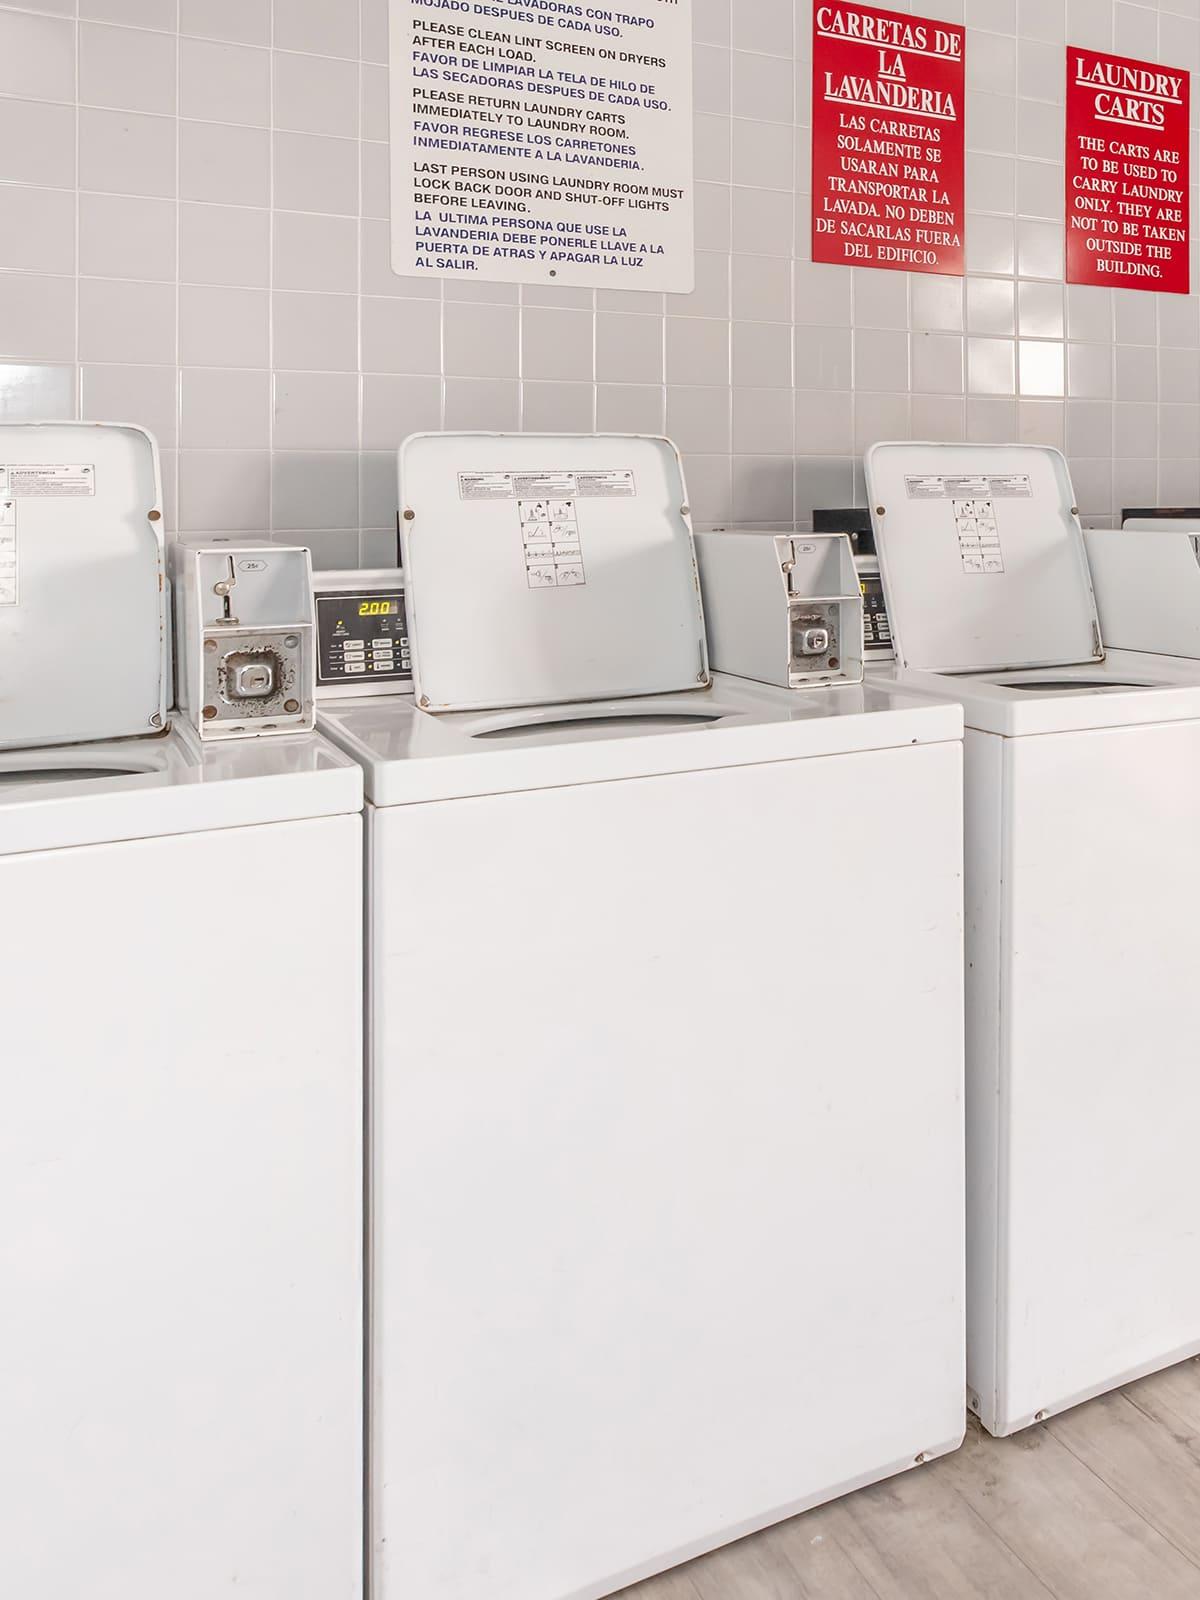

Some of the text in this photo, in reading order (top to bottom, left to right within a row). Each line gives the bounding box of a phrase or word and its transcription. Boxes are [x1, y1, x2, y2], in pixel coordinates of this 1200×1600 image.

[474, 4, 534, 23] DESPUES
[538, 15, 554, 26] DE
[558, 18, 592, 32] CADA
[595, 24, 623, 38] USO.
[586, 8, 612, 21] CON
[615, 13, 654, 29] TRAPO
[817, 7, 961, 56] CARRETAS DE
[412, 35, 536, 63] AFTER EACH LOAD.
[413, 19, 666, 68] PLEASE CLEAN LINT SCREEN ON DRYERS
[413, 51, 655, 95] FAVOR DE LIMPIAR LA TELA DE HILO DE
[879, 50, 906, 77] LA
[1077, 58, 1182, 97] LAUNDRY
[413, 66, 671, 111] LAS SECADORAS DESPUES DE CADA USO.
[825, 72, 956, 116] LAVANDERIA
[413, 88, 626, 125] PLEASE RETURN LAUNDRY CARTS
[1095, 93, 1164, 124] CARTS
[413, 103, 629, 139] IMMEDIATELY TO LAUNDRY ROOM.
[840, 114, 940, 142] LAS CARRETAS
[414, 121, 636, 156] FAVOR REGRESE LOS CARRETONES
[838, 135, 941, 163] SOLAMENTE SE
[1078, 136, 1179, 164] THE CARTS ARE
[414, 136, 644, 171] INMEDIATAMENTE A LA LAVANDERIA.
[414, 162, 684, 199] LAST PERSON USING LAUNDRY ROOM MUST
[841, 156, 939, 183] USARAN PARA
[1081, 156, 1177, 182] TO BE USED TO
[414, 177, 669, 212] LOCK BACK DOOR AND SHUT-OFF LIGHTS
[414, 193, 531, 213] BEFORE LEAVING.
[828, 176, 950, 205] TRANSPORTAR LA
[1073, 176, 1183, 203] CARRY LAUNDRY
[824, 197, 954, 225] LAVADA. NO DEBEN
[1075, 196, 1182, 222] ONLY. THEY ARE
[415, 210, 627, 237] LA ULTIMA PERSONA QUE USE LA
[816, 218, 960, 247] DE SACARLAS FUERA
[1071, 216, 1185, 241] NOT TO BE TAKEN
[416, 226, 664, 254] LAVANDERIA DEBE PONERLE LLAVE A LA
[416, 241, 643, 267] PUERTA DE ATRAS Y APAGAR LA LUZ
[845, 242, 939, 265] DEL EDIFICIO.
[1086, 238, 1171, 259] OUTSIDE THE
[415, 257, 478, 271] AL SALIR.
[1097, 259, 1162, 278] BUILDING.
